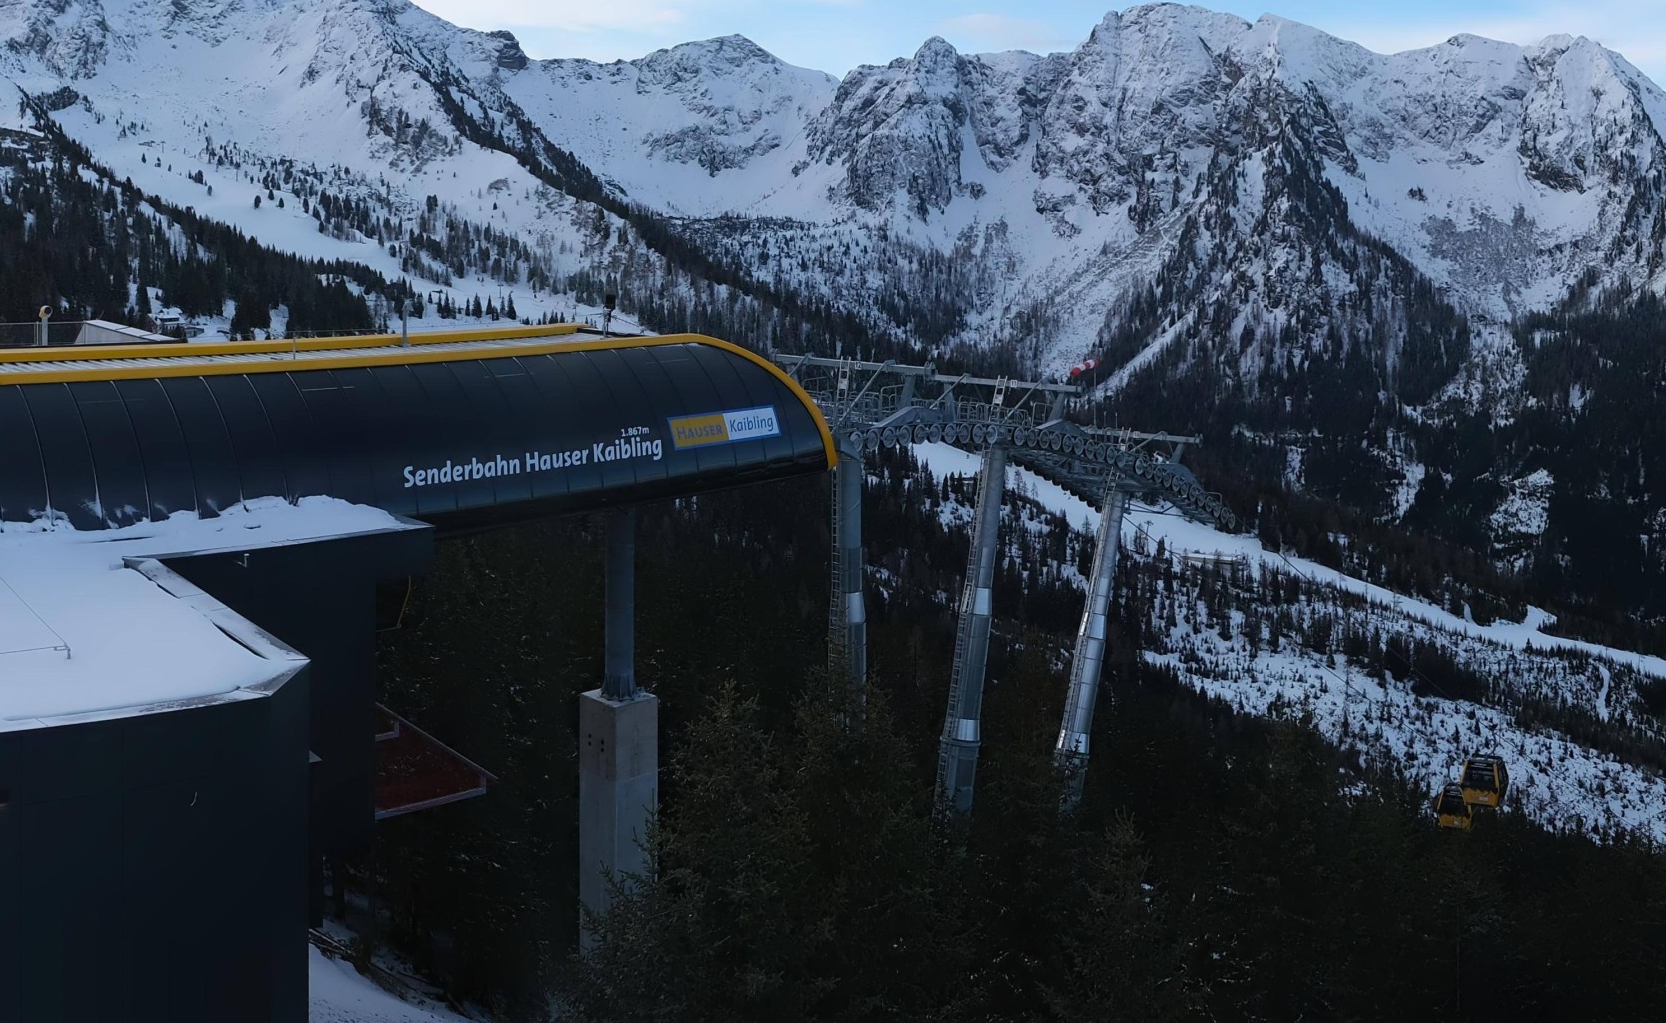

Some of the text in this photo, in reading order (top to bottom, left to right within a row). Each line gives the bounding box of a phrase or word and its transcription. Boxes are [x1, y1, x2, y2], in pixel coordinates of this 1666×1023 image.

[620, 426, 650, 437] 1.867m
[676, 415, 774, 439] HAUSER Kaibling
[403, 436, 663, 488] Senderbahn Hauser Kaibling
